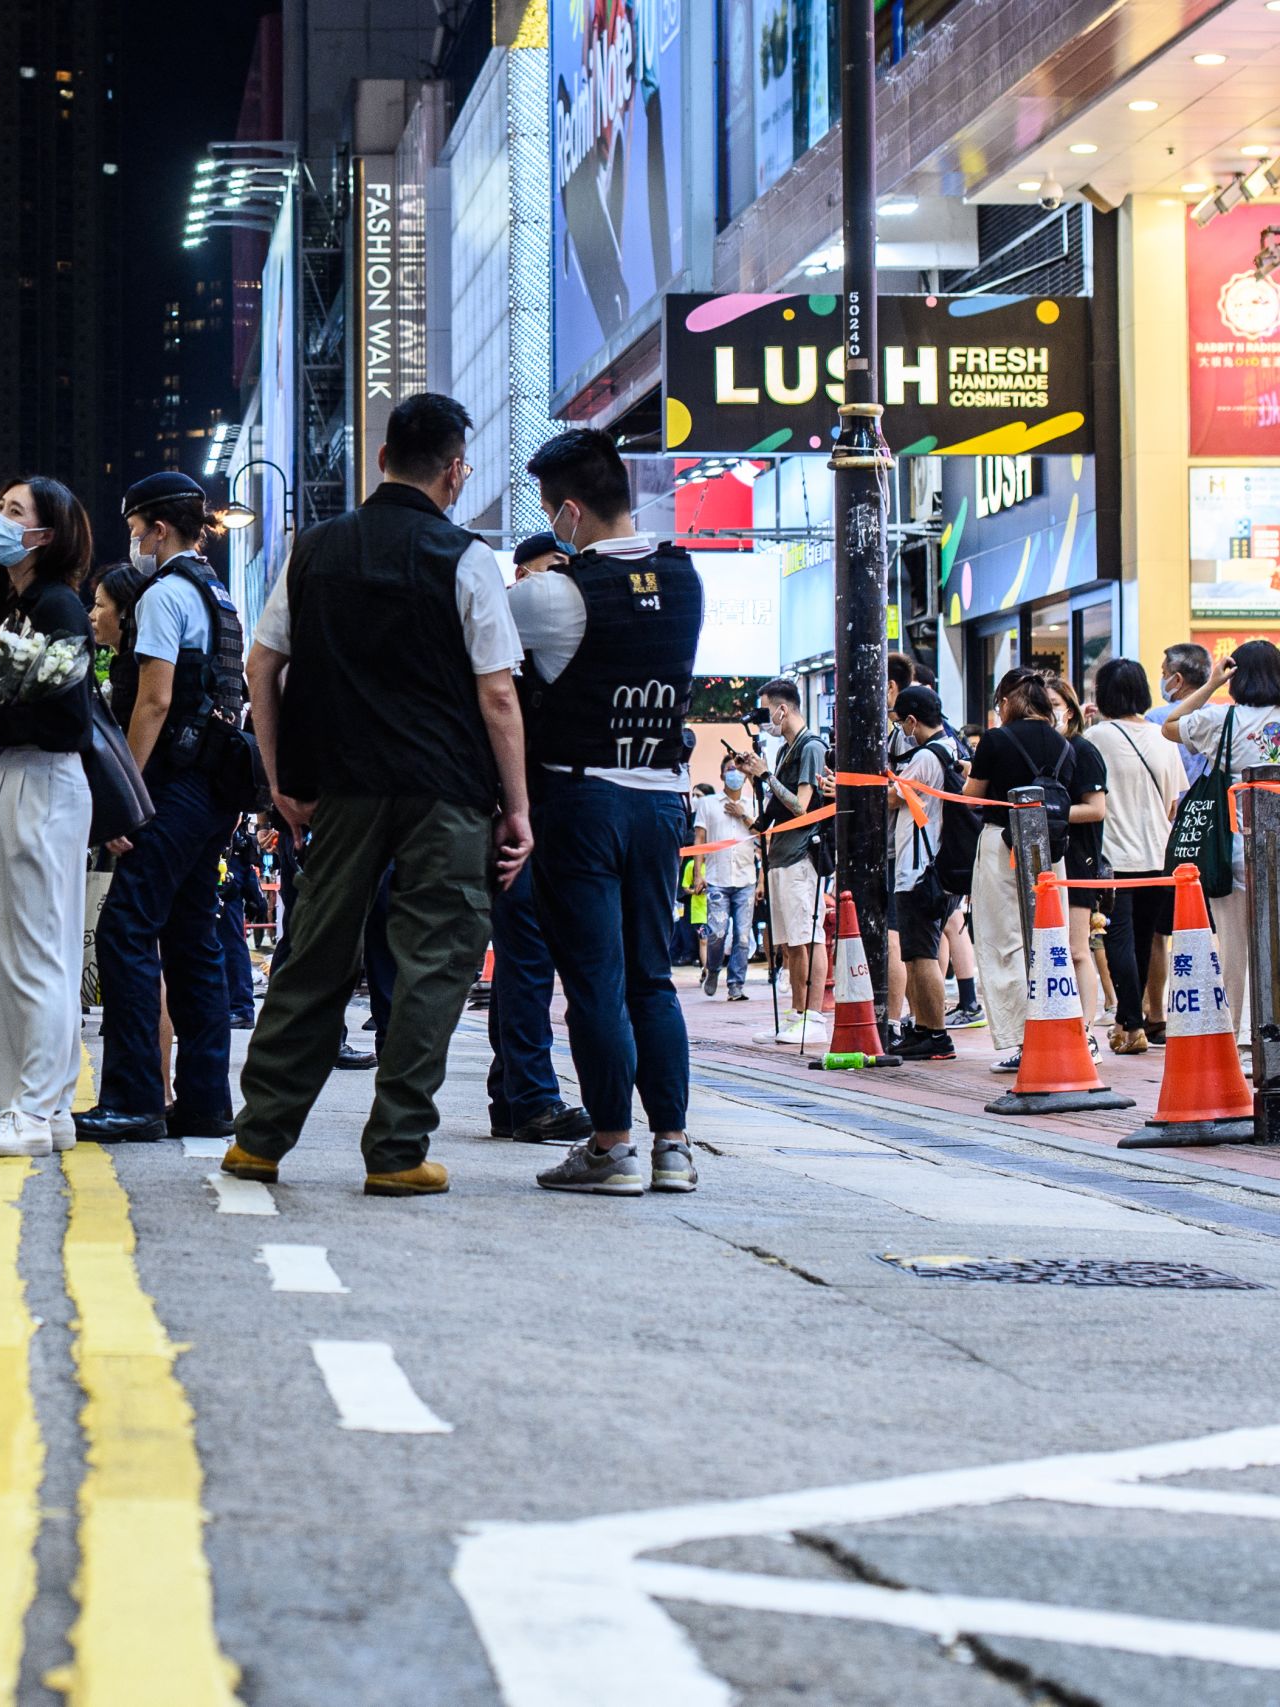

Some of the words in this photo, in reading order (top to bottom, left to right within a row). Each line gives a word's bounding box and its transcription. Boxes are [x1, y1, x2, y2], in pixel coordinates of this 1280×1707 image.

[367, 184, 391, 311] FASHION
[849, 292, 860, 356] 50240
[367, 319, 391, 399] WALK
[949, 347, 1049, 373] FRESH
[949, 374, 1049, 391] HANDMADE
[949, 391, 1049, 408] COSMETICS
